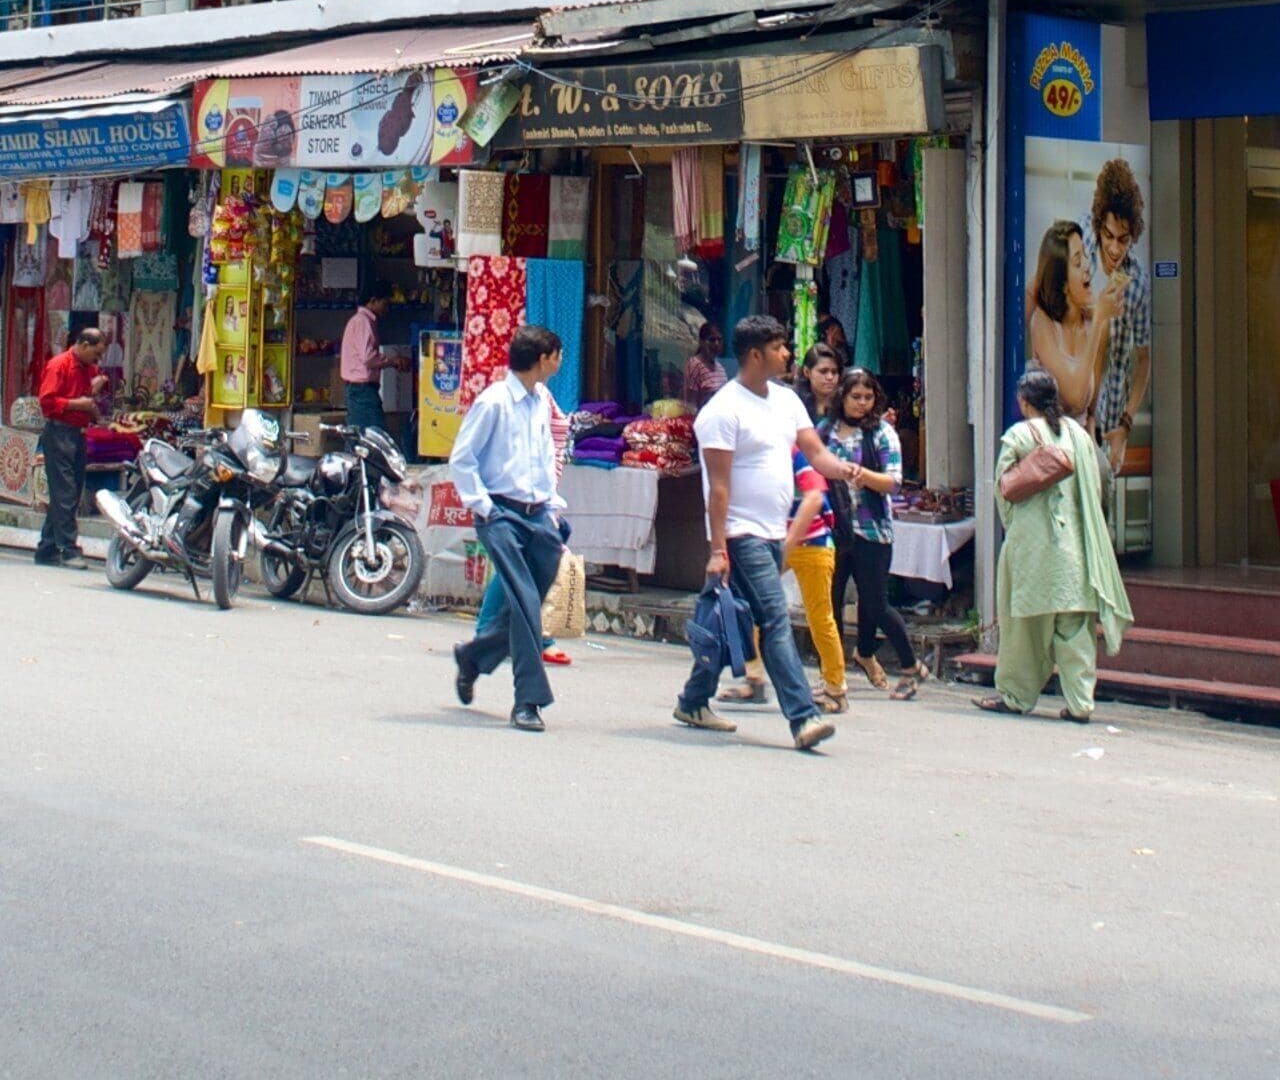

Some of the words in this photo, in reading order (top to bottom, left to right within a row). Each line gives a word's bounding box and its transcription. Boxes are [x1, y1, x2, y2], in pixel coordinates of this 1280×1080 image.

[1030, 42, 1060, 90] PIZZA
[1060, 41, 1094, 95] MANIA
[308, 89, 341, 107] TIWARI
[357, 84, 389, 95] CHOCO
[601, 82, 620, 112] &
[630, 71, 727, 111] SONS
[301, 113, 347, 130] GENERAL
[43, 127, 106, 149] SHAWL
[108, 120, 180, 144] HOUSE
[104, 144, 128, 154] BED
[131, 140, 181, 152] COVERS
[308, 138, 340, 154] STORE
